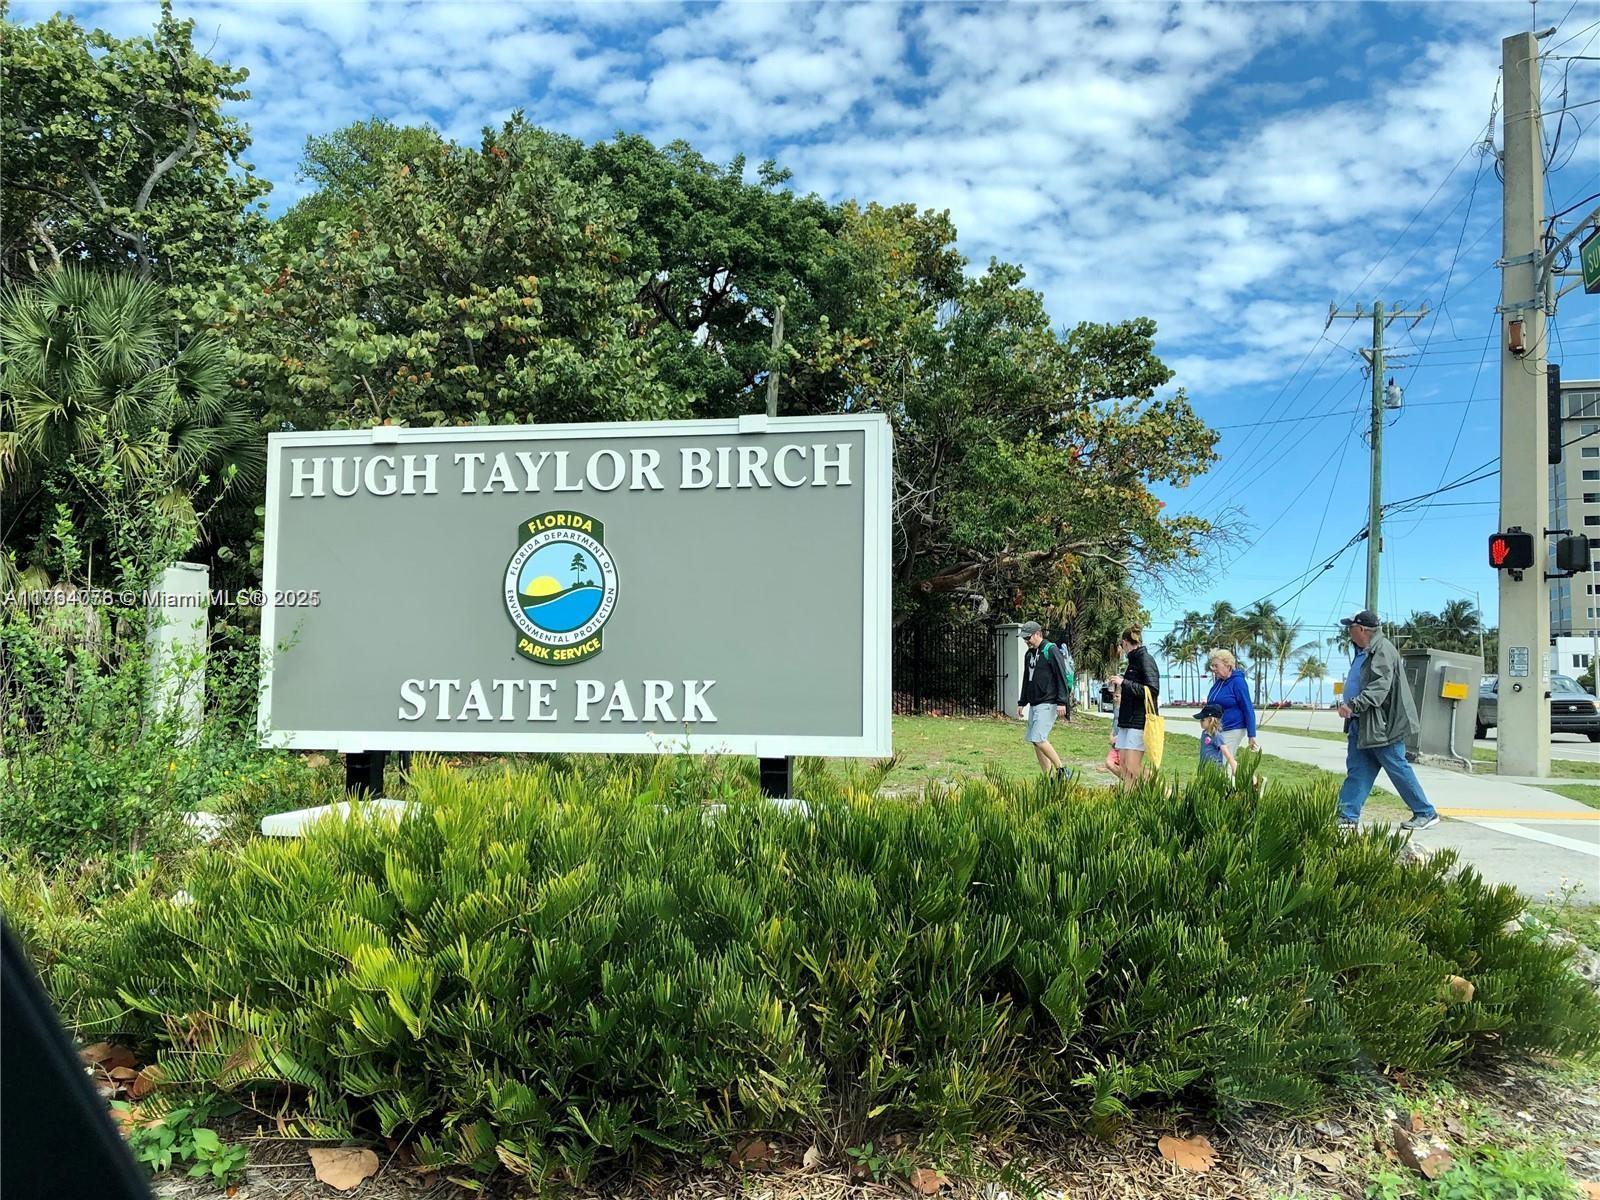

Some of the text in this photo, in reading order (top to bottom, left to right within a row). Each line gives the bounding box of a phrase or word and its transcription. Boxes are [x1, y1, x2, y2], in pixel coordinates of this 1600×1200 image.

[1588, 245, 1600, 273] SU
[289, 442, 853, 498] HUGH TAYLOR BIRCH
[528, 514, 592, 534] FLORIDA
[510, 531, 613, 576] FLORIDA DEPARTMENT OF
[507, 587, 615, 643] ENVIRONMENTAL PROTECTION
[518, 637, 601, 660] PARK SERVICE
[397, 678, 719, 723] STATE PARK
